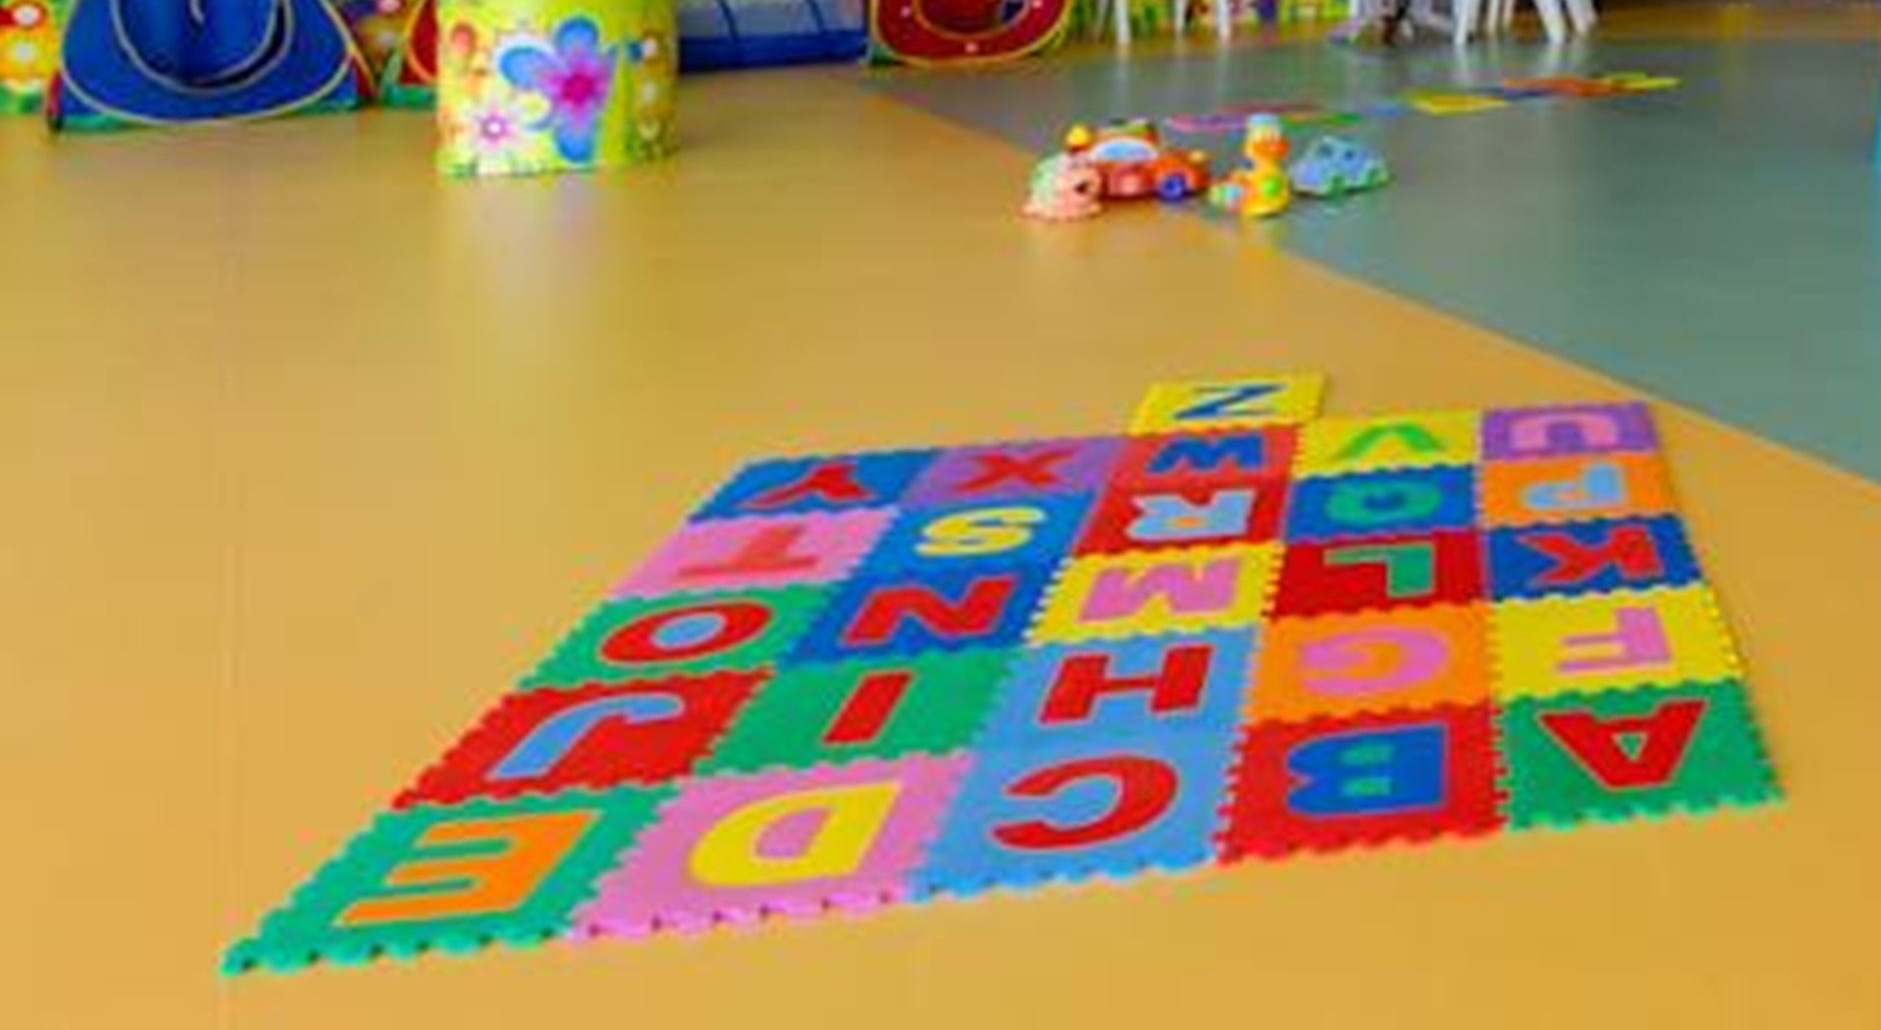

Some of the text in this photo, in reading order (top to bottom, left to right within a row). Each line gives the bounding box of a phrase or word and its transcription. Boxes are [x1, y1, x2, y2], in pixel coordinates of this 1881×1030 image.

[1173, 384, 1288, 419] Z
[742, 413, 1620, 507] U V W X Y
[1520, 462, 1626, 512] P
[914, 507, 1048, 556] S
[1126, 490, 1249, 541] R
[676, 524, 819, 582] T
[600, 526, 1663, 664] K L M N O
[489, 605, 1673, 781] F G H I J
[333, 699, 1708, 928] A B C D E
